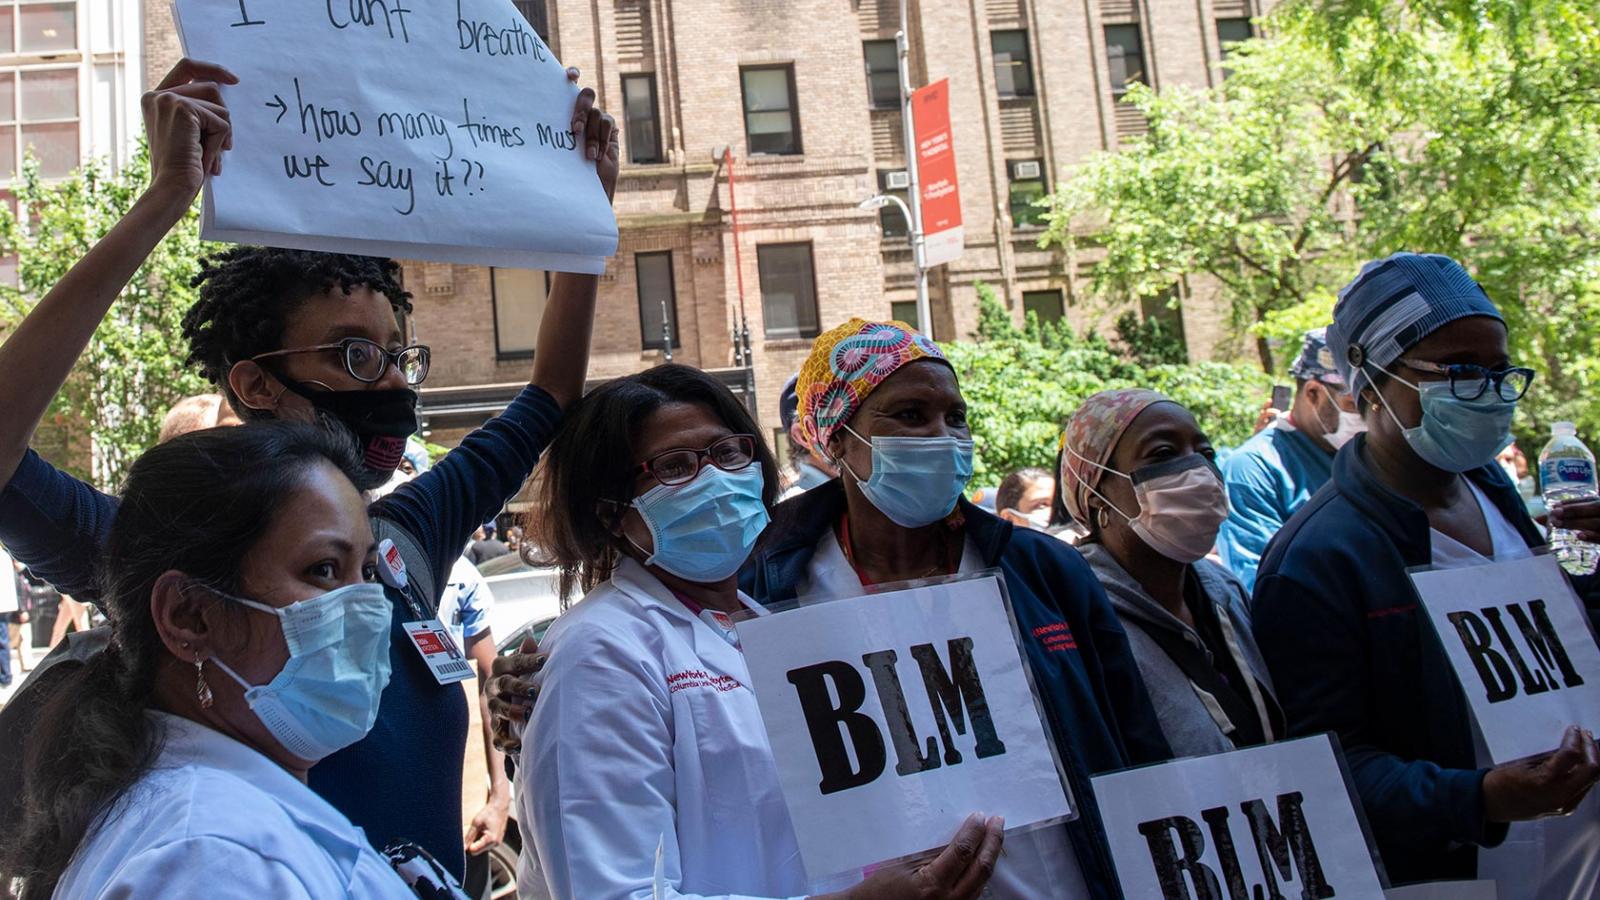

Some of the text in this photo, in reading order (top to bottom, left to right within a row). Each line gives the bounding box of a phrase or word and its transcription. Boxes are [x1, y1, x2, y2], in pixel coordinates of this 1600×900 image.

[231, 0, 265, 27] I
[457, 0, 546, 63] breathe
[294, 78, 362, 143] how
[378, 112, 453, 160] many
[457, 98, 525, 149] times
[284, 154, 485, 215] we say it??
[1446, 598, 1585, 705] BLM
[786, 636, 1007, 795] BLM
[1137, 791, 1336, 900] BLM
